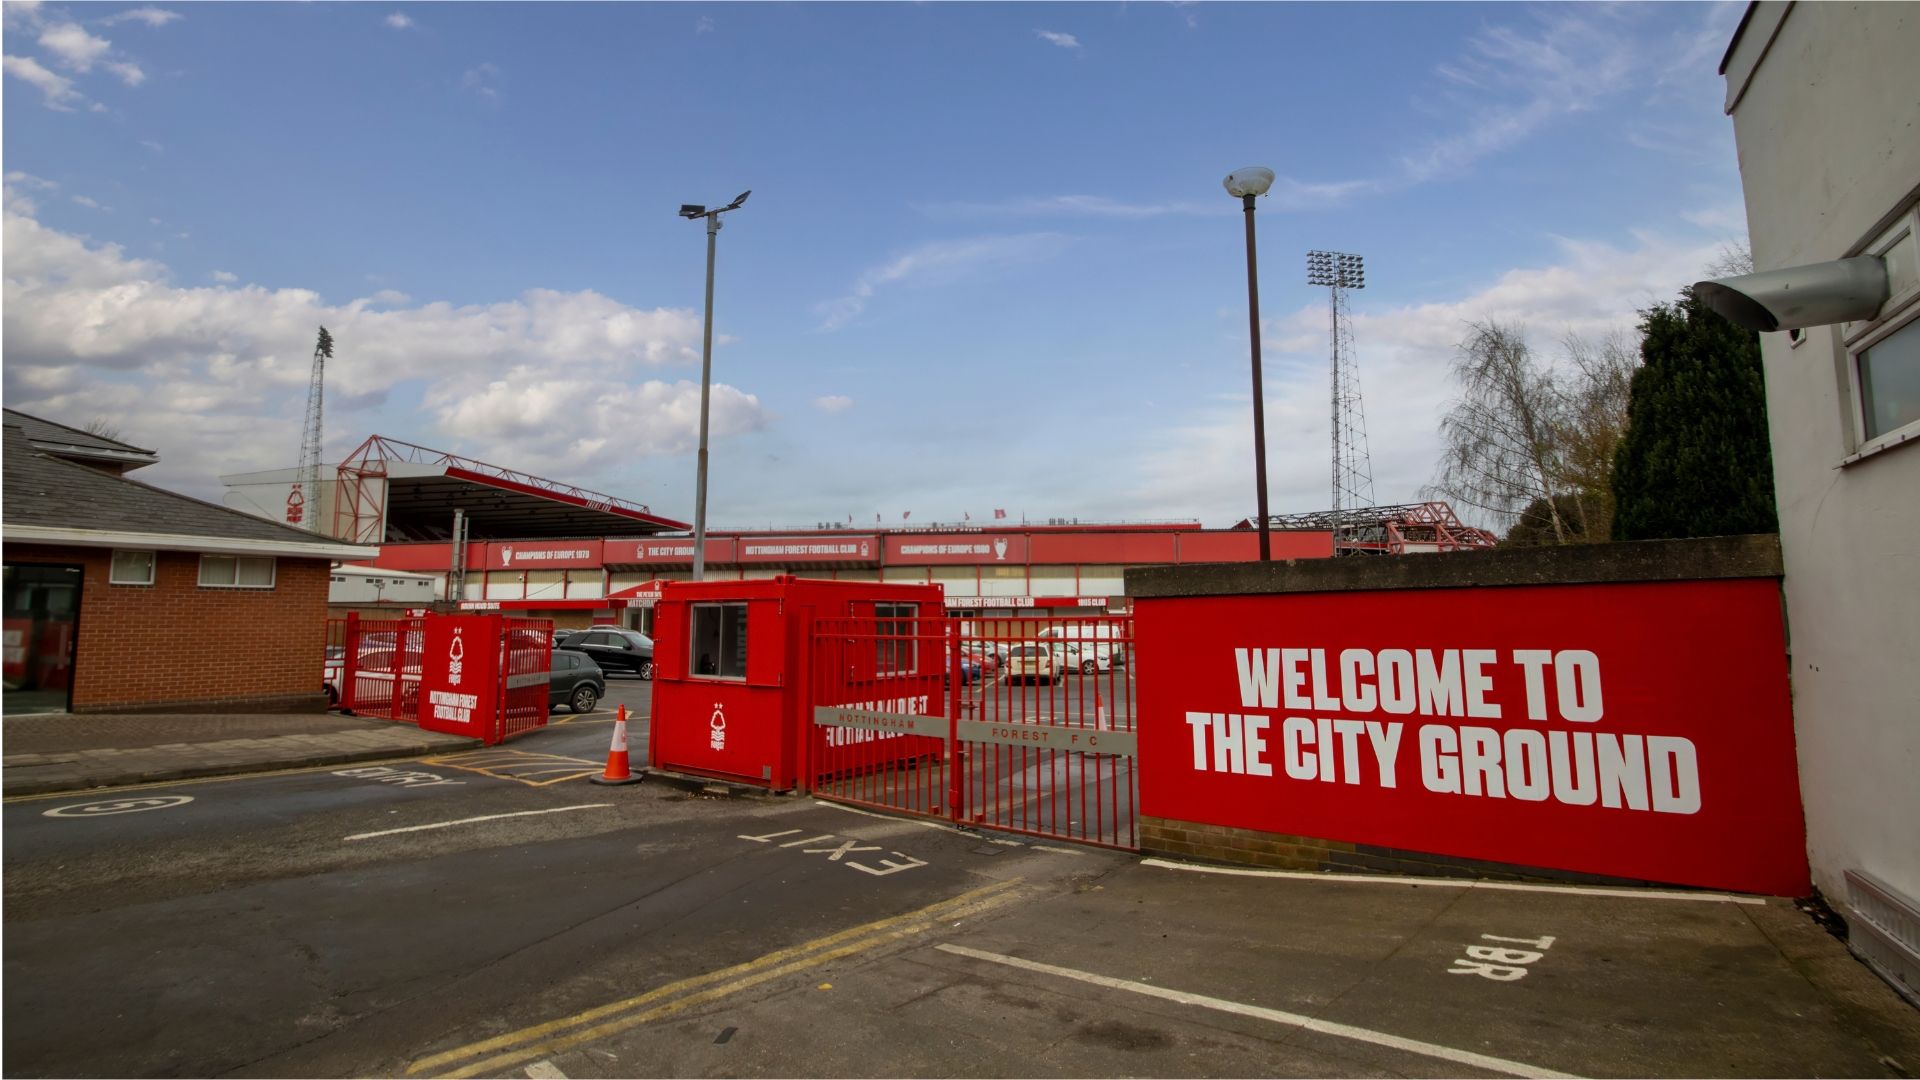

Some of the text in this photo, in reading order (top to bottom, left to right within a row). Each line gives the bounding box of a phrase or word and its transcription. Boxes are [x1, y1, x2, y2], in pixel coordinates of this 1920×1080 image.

[515, 551, 546, 560] CHAMPIONS
[546, 551, 553, 560] OF
[553, 550, 576, 559] EUROPE
[648, 547, 695, 556] THE CITY GROUN
[745, 544, 857, 556] NOTTINGHAM FOREST FOOTBALL CLUB
[901, 545, 938, 554] CHAMPIONS
[938, 545, 946, 554] OF
[947, 545, 973, 554] EUROPE
[959, 597, 982, 608] FOREST
[982, 597, 1016, 608] FOOTBALL
[1016, 597, 1035, 608] CLUB
[1092, 598, 1106, 607] CLUB
[1234, 648, 1603, 723] WELCOME TO
[429, 690, 478, 710] NOTTINGHAM FOREST
[434, 705, 470, 723] FOOTBALL CLUB
[838, 713, 915, 729] NOTTINGHAM
[992, 727, 1098, 746] FOREST F C
[1186, 711, 1702, 815] THE CITY GROUND
[330, 766, 468, 788] ENTRY
[737, 829, 930, 876] EXIT
